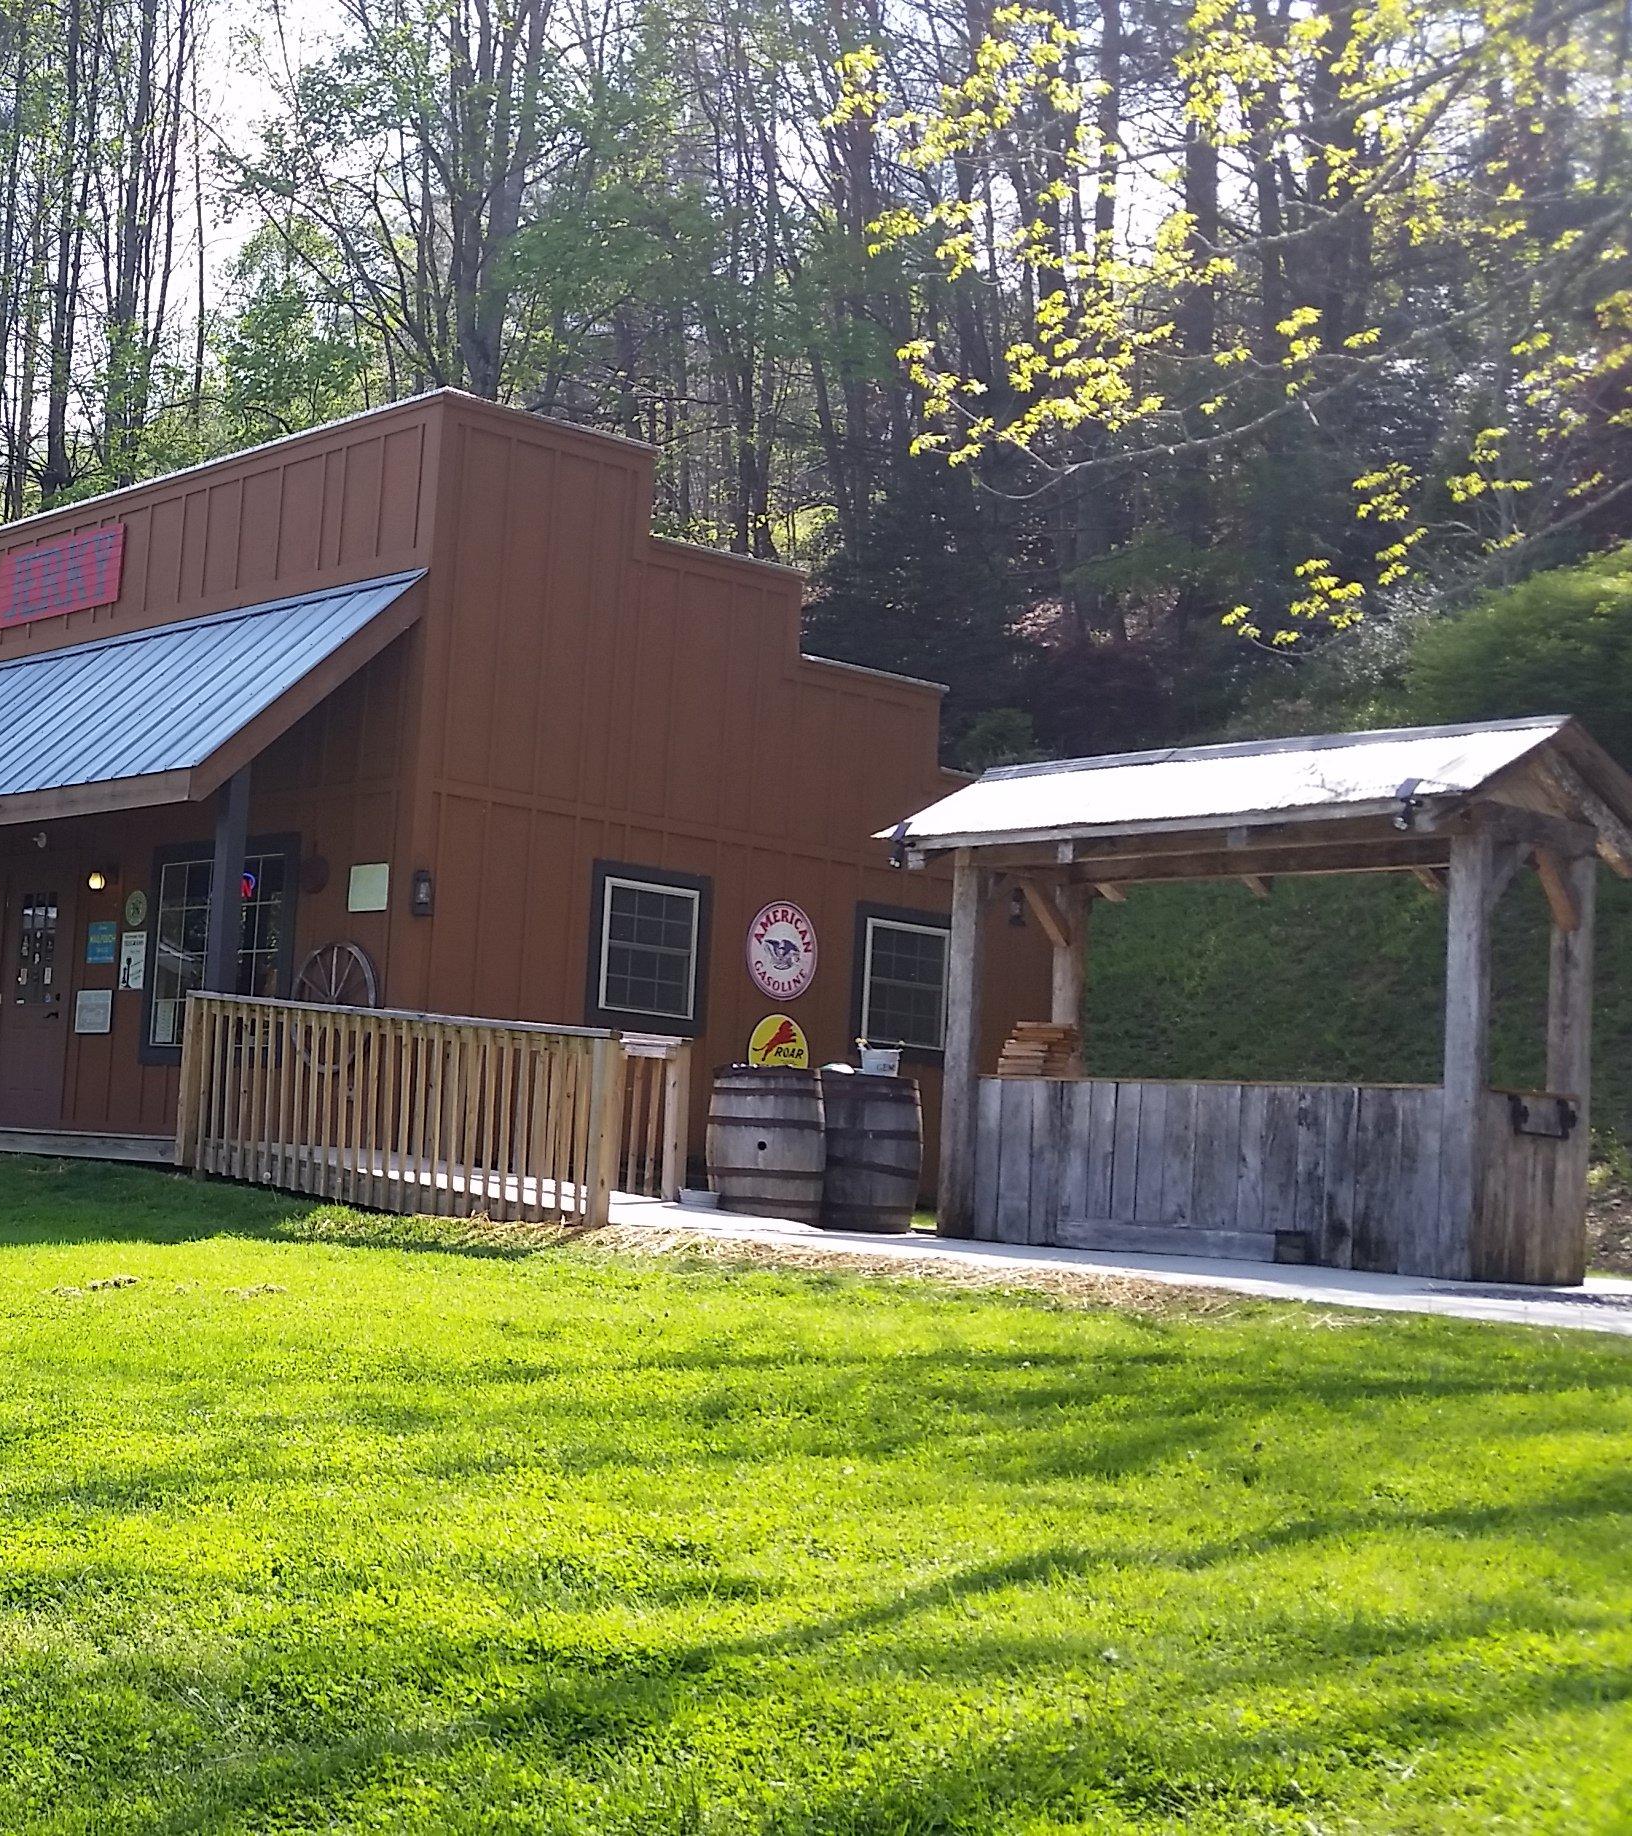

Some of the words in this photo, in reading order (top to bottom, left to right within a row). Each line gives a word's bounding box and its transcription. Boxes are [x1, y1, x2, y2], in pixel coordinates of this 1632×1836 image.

[3, 530, 116, 620] JERKY
[753, 909, 813, 954] AMERICAN
[753, 960, 809, 992] GASOLINE
[774, 1046, 804, 1060] ROAR
